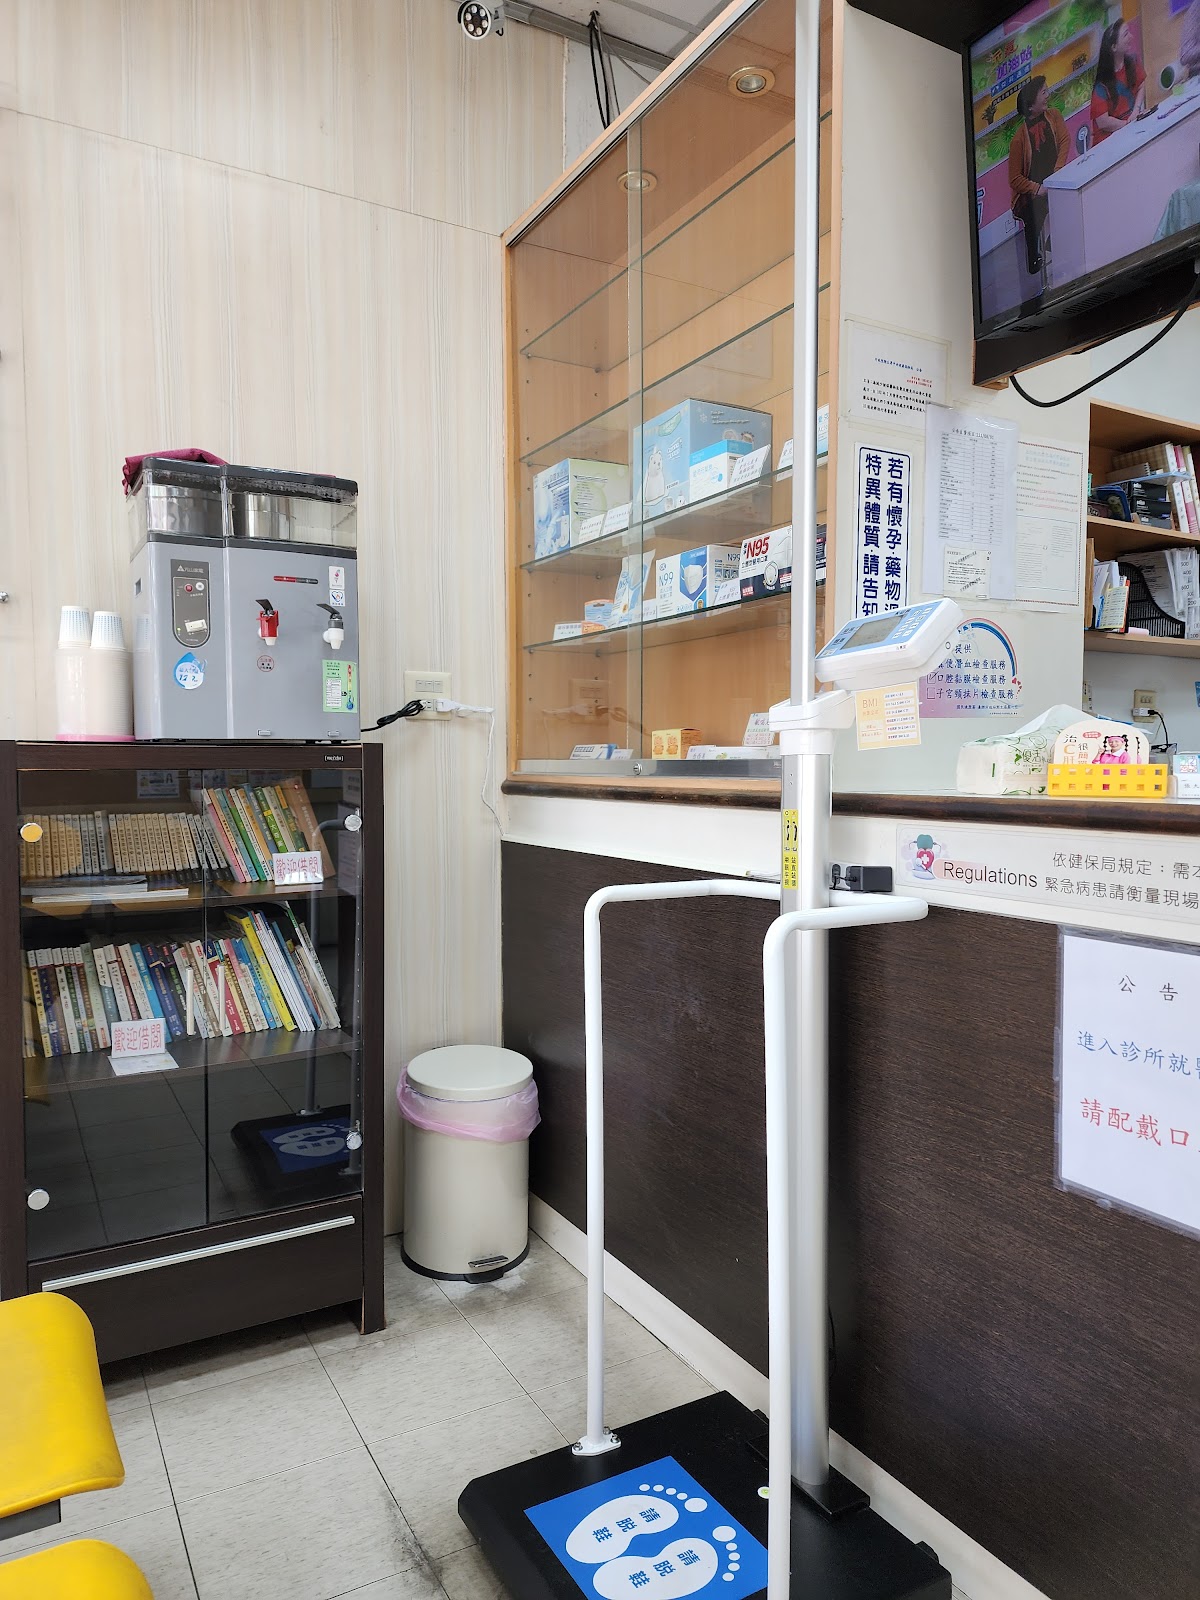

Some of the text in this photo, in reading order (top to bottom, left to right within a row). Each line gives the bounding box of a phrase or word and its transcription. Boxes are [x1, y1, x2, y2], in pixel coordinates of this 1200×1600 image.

[746, 535, 770, 559] N95
[659, 571, 674, 586] N99
[954, 643, 972, 654] 提供
[862, 698, 878, 709] BMI
[943, 861, 1038, 889] Regulations
[114, 1023, 161, 1053] 歡迎借閱
[1076, 1030, 1200, 1080] 進入診所就
[1080, 1097, 1200, 1152] 請配戴口
